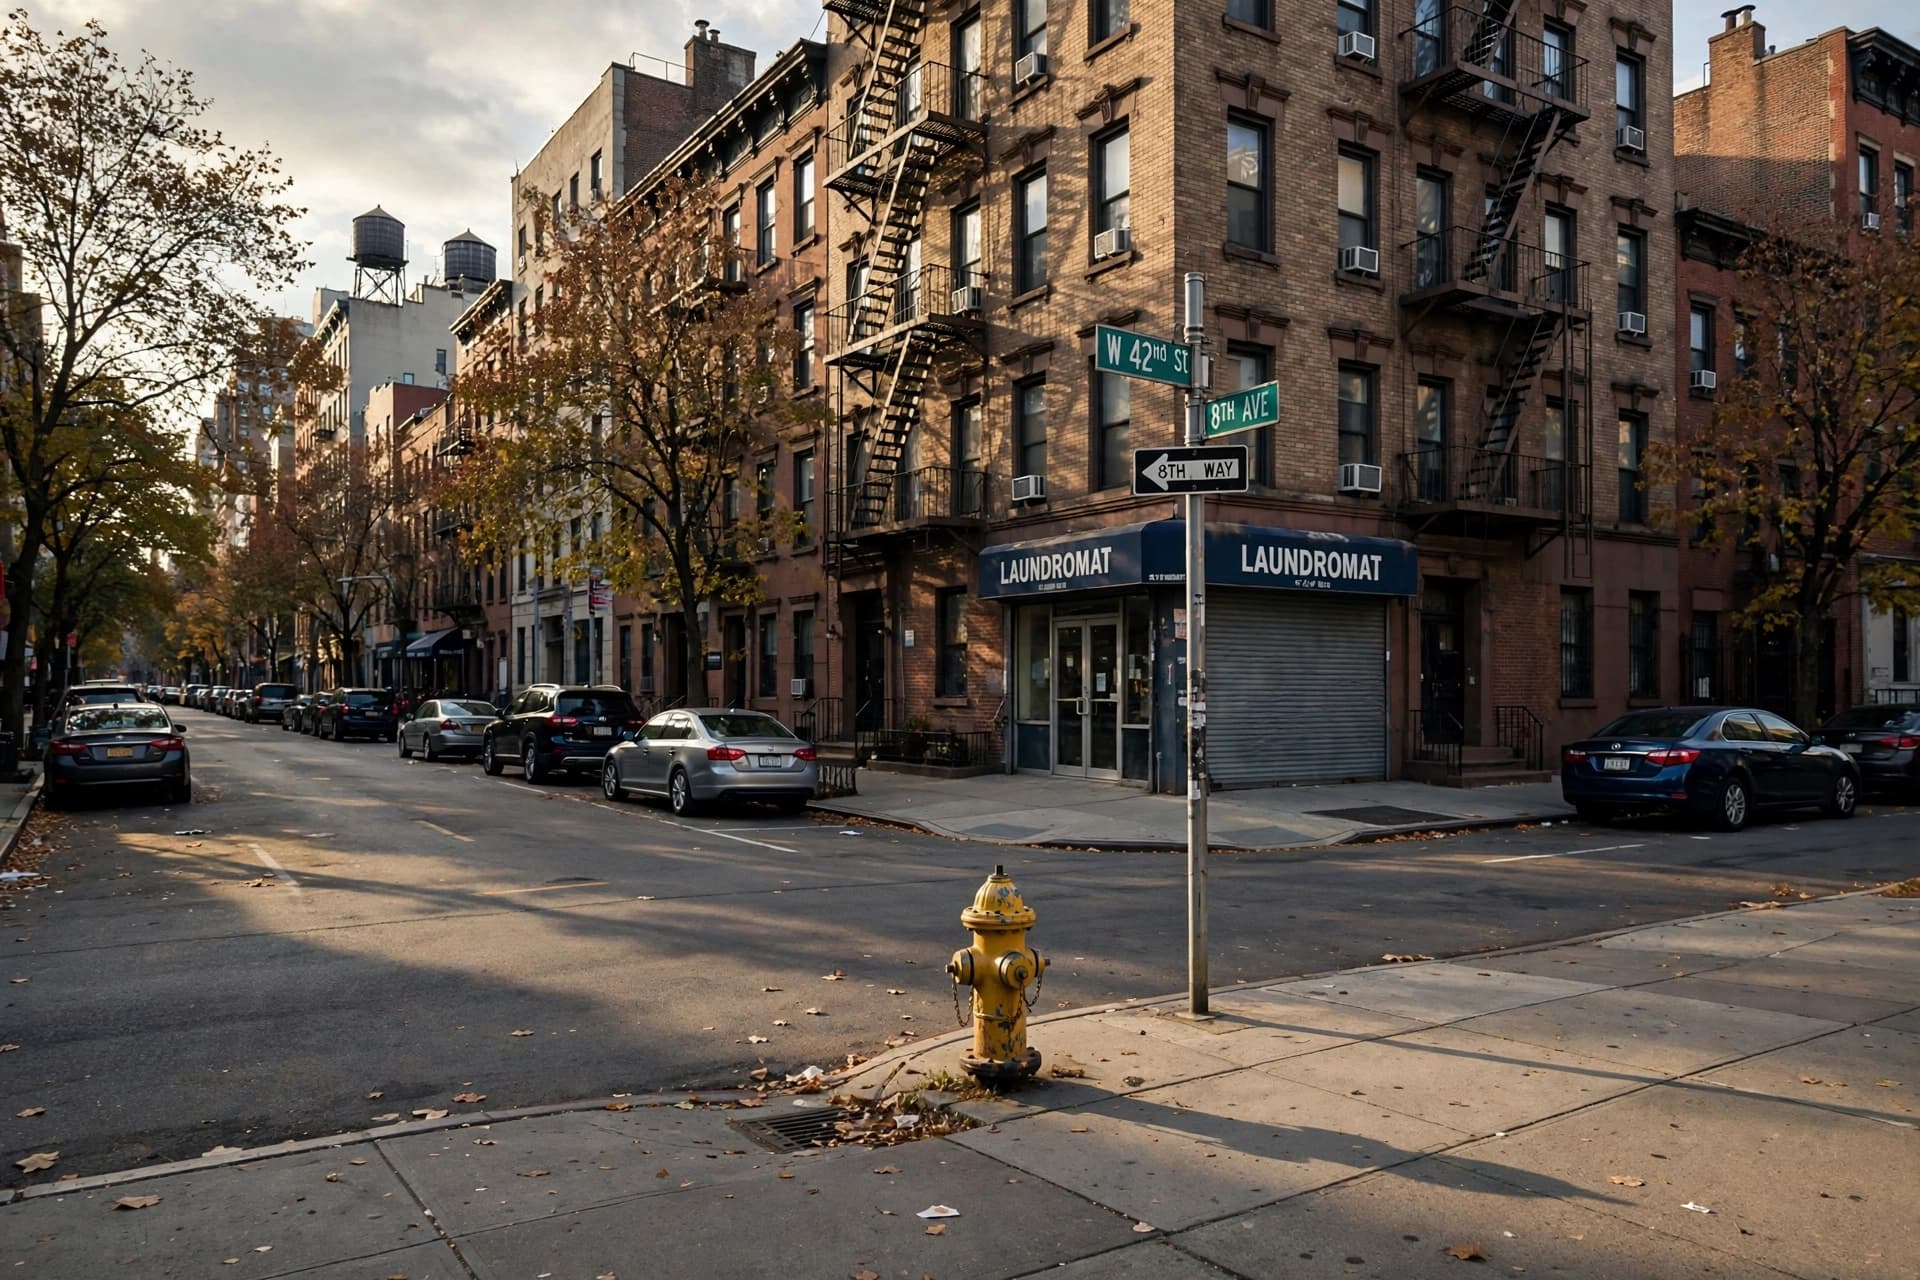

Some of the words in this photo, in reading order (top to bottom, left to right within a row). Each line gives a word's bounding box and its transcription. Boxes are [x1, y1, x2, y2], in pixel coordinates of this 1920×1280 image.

[1106, 333, 1122, 366] W
[1211, 400, 1235, 430] 8TH
[1242, 390, 1269, 422] AVE
[1158, 463, 1186, 479] 8TH
[1204, 461, 1233, 478] WAY
[1000, 546, 1112, 585] LAUNDROMAT
[1241, 544, 1383, 581] LAUNDROMAT
